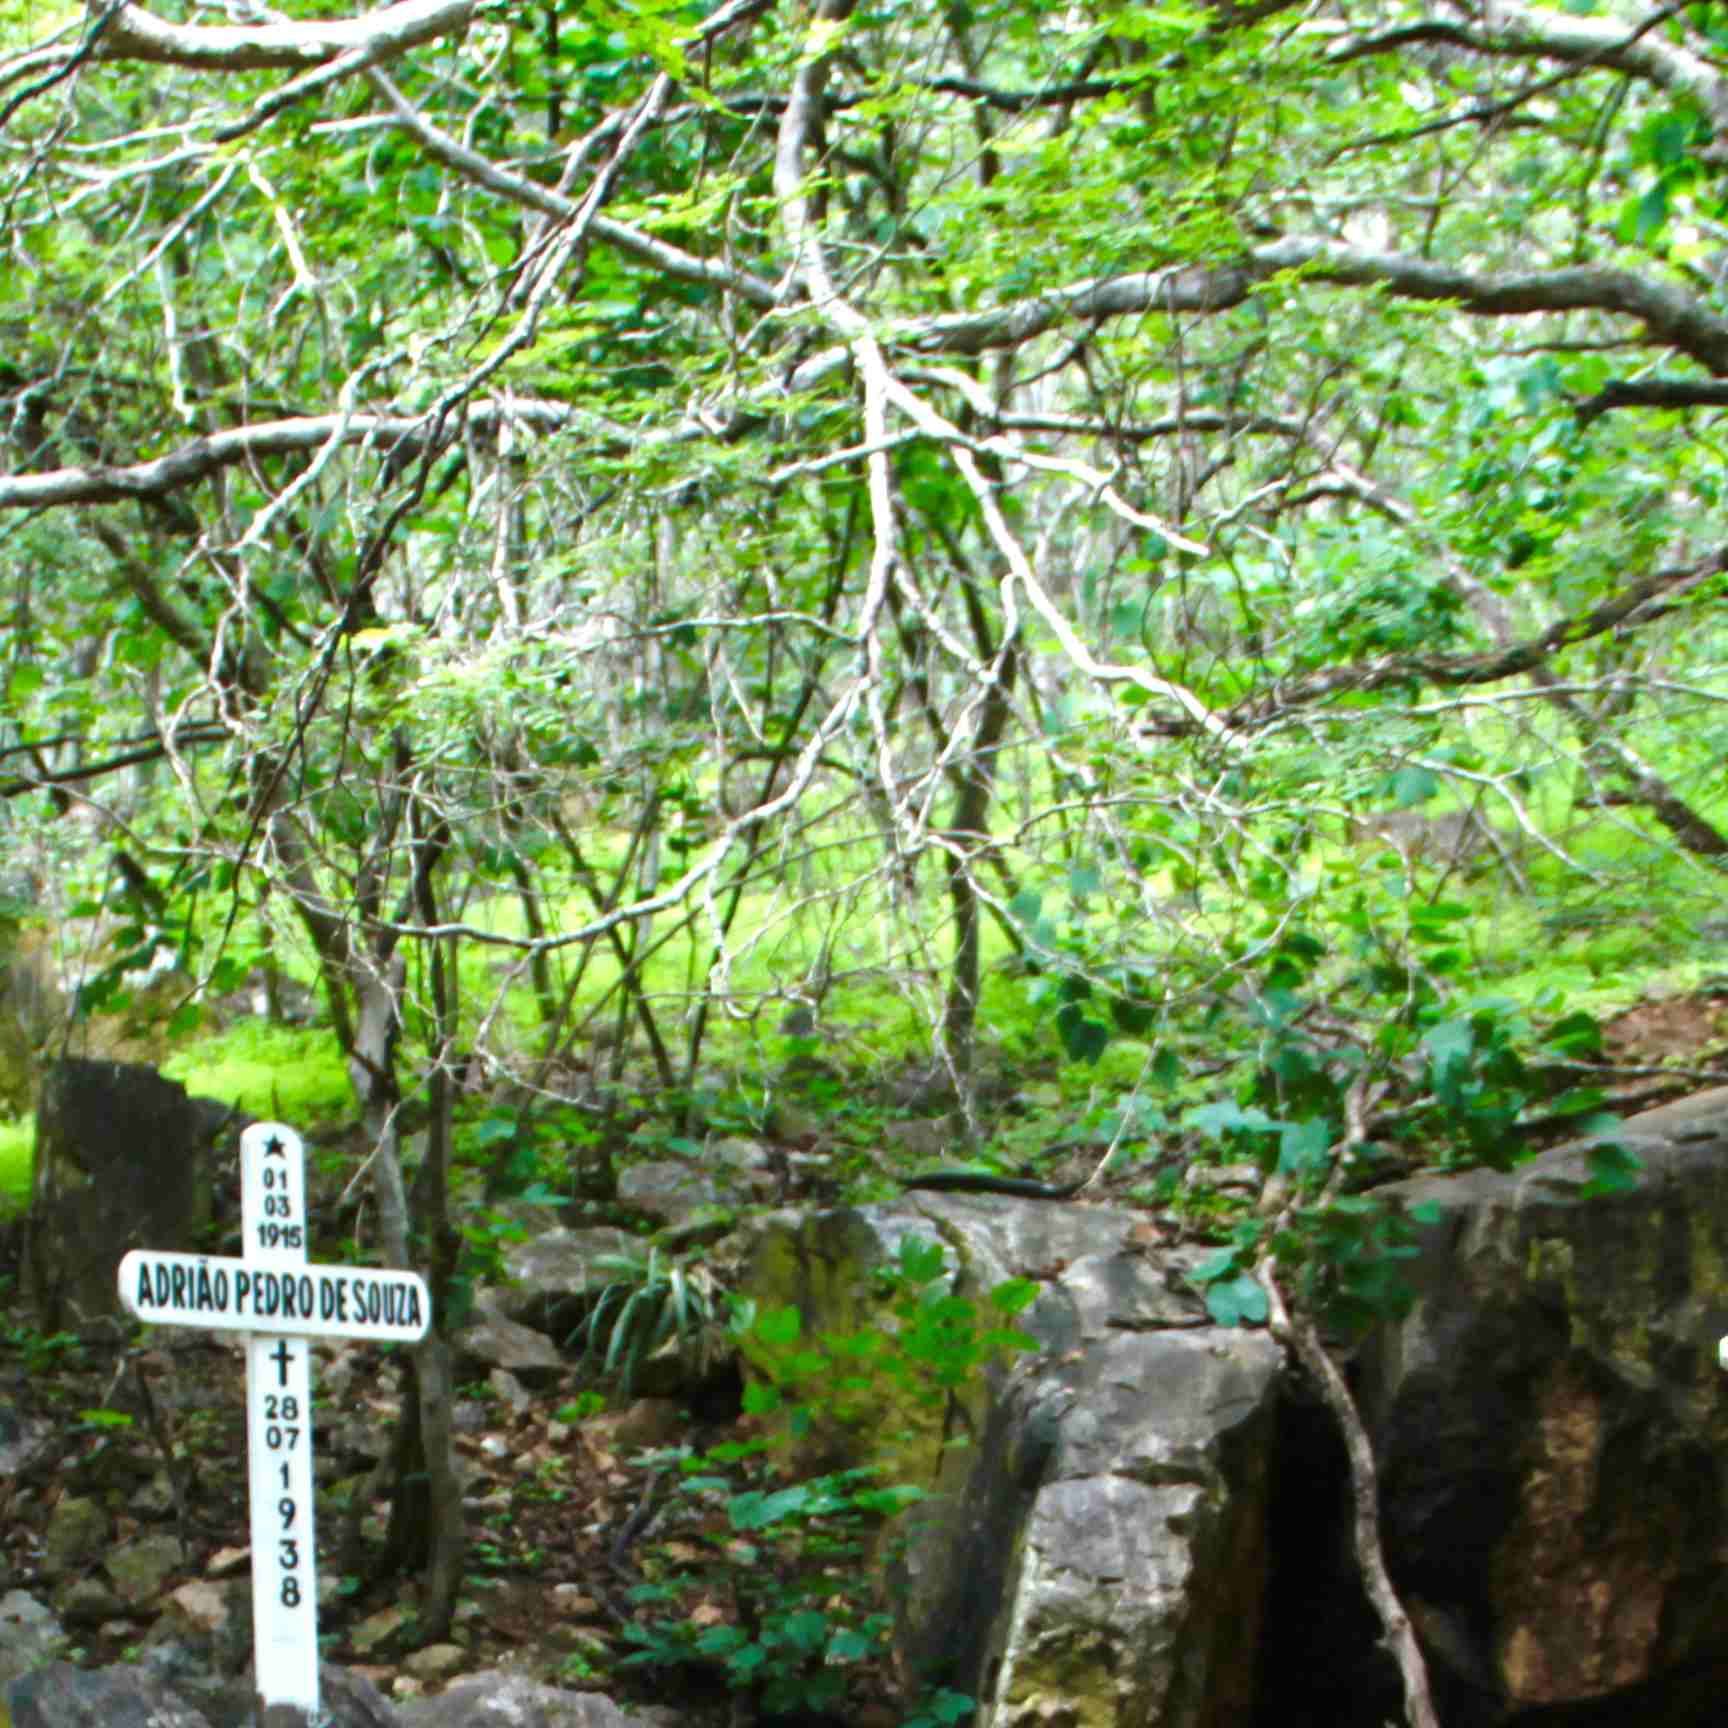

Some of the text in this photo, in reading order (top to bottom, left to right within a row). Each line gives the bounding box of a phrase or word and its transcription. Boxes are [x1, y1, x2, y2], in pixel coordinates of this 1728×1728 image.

[263, 1167, 288, 1190] 01
[264, 1194, 291, 1218] 03
[257, 1222, 303, 1249] 1915
[137, 1256, 423, 1328] ADRIÃO PEDRO DE SOUZA
[264, 1394, 299, 1421] 28
[265, 1425, 300, 1451] 07
